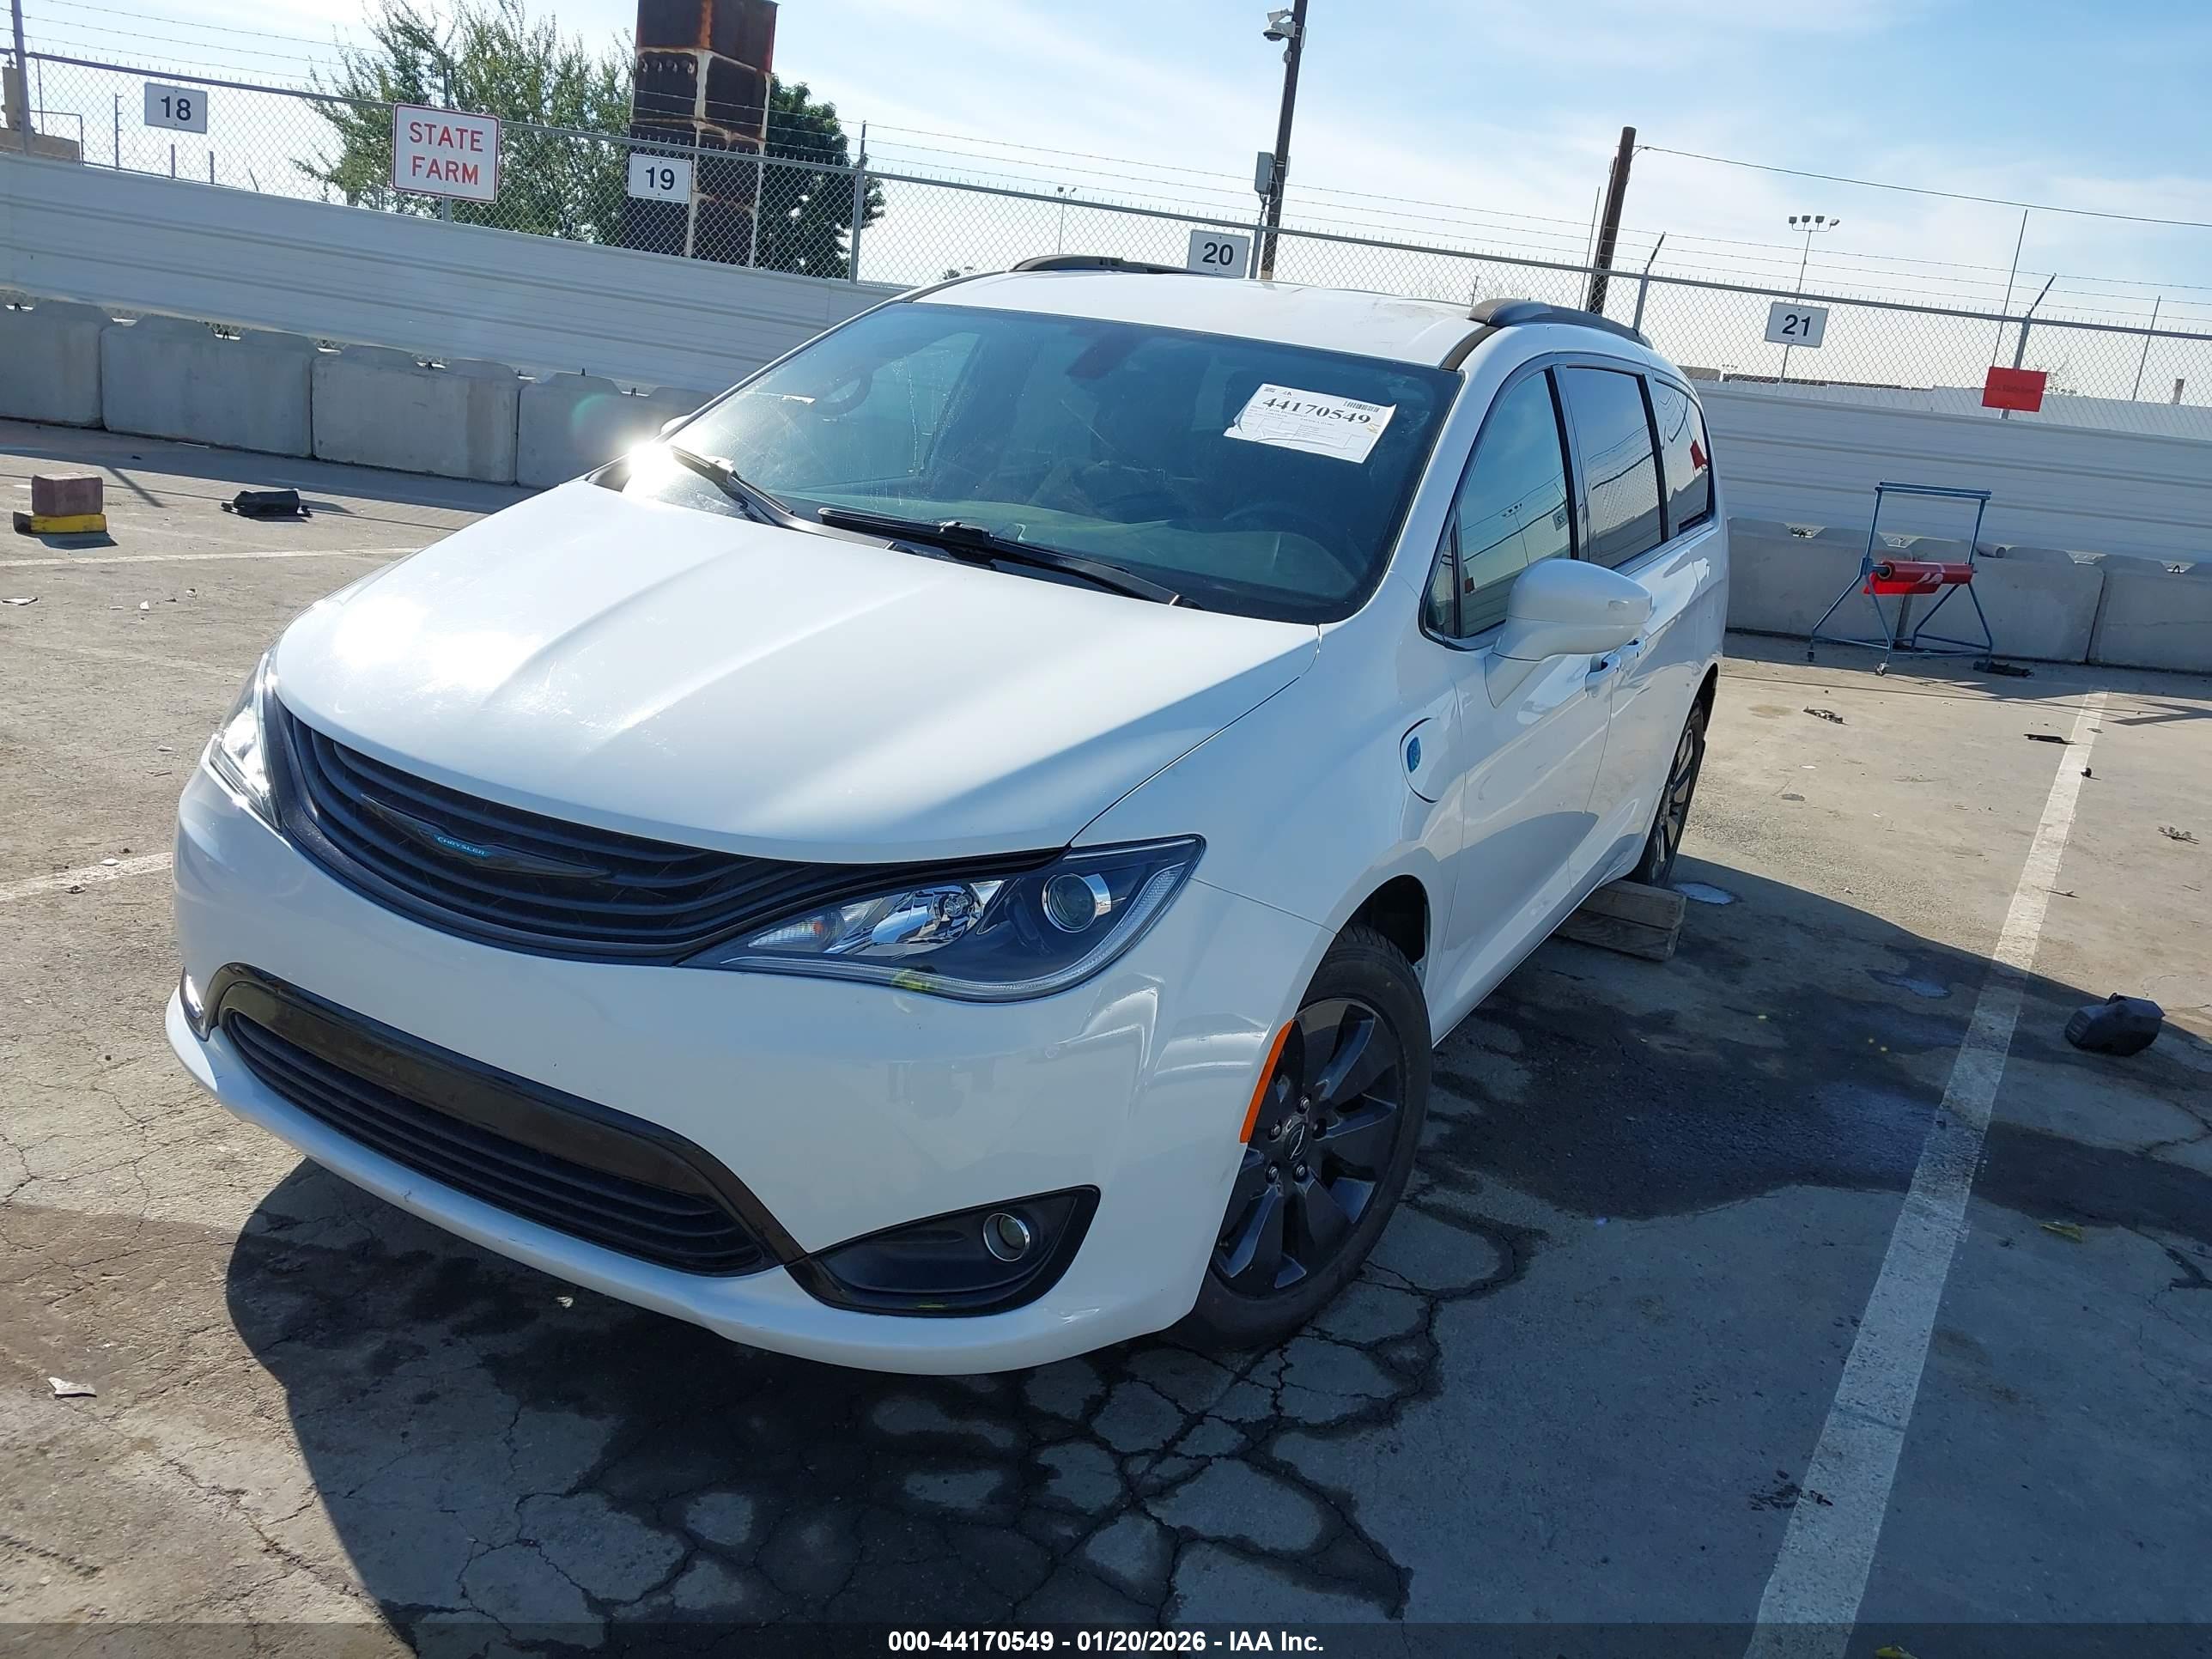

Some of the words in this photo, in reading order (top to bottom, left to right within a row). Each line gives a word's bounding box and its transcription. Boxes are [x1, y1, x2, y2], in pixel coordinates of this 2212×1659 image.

[160, 95, 191, 122] 18
[409, 121, 483, 153] STATE
[411, 155, 479, 185] FARM
[645, 166, 675, 191] 19
[1201, 241, 1234, 266] 20
[1781, 313, 1811, 337] 21
[1262, 398, 1371, 424] 44170549
[437, 836, 485, 855] CHRYSLER
